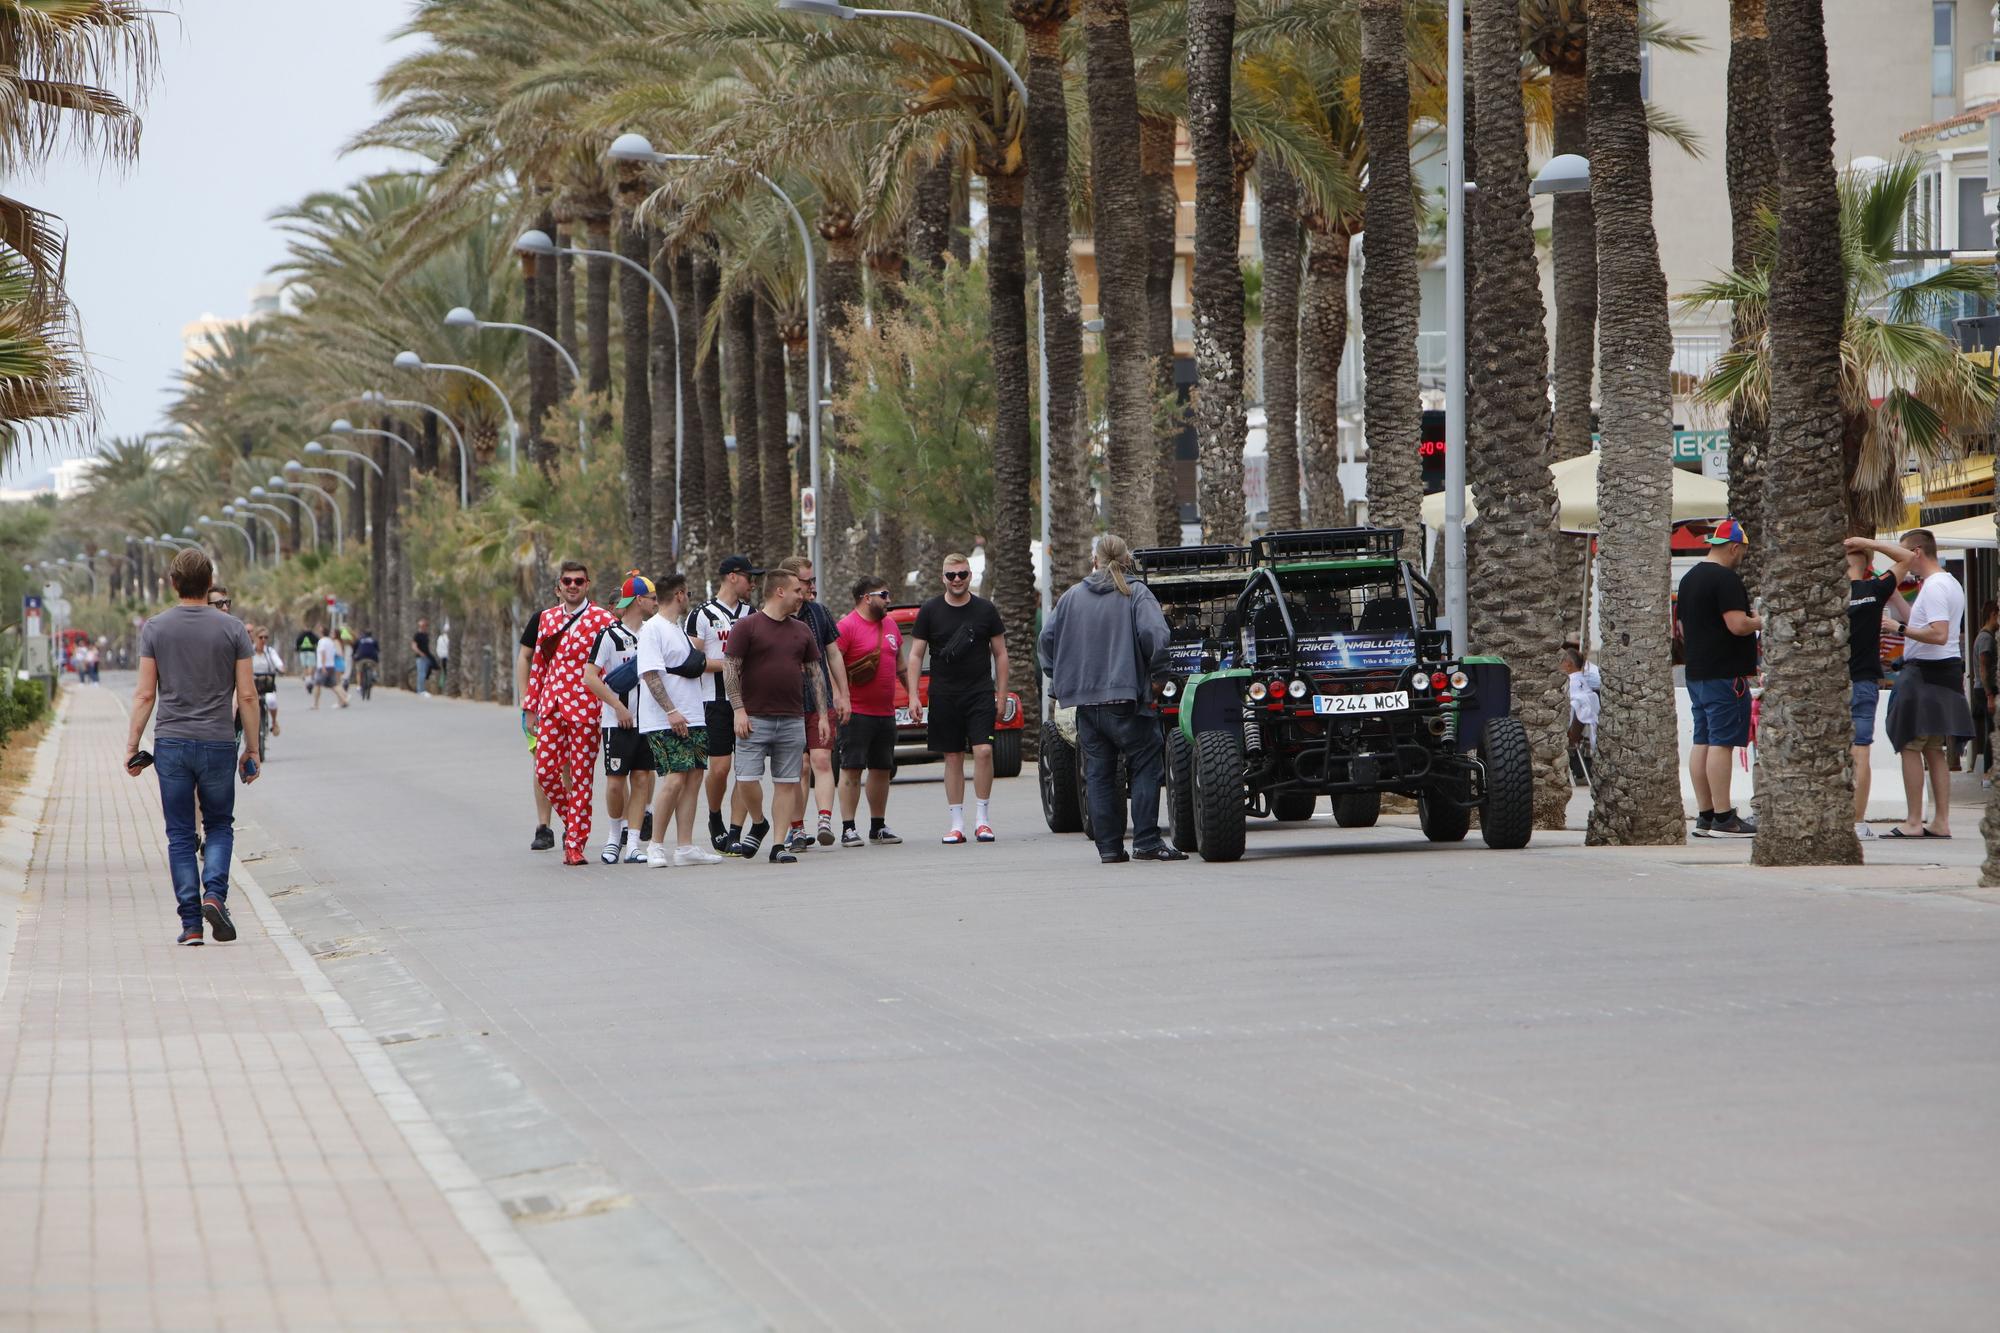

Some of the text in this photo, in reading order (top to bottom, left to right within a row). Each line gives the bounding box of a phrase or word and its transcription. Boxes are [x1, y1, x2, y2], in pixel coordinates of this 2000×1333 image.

[1392, 647, 1415, 656] .COM
[1324, 693, 1405, 712] 7244 MCK
